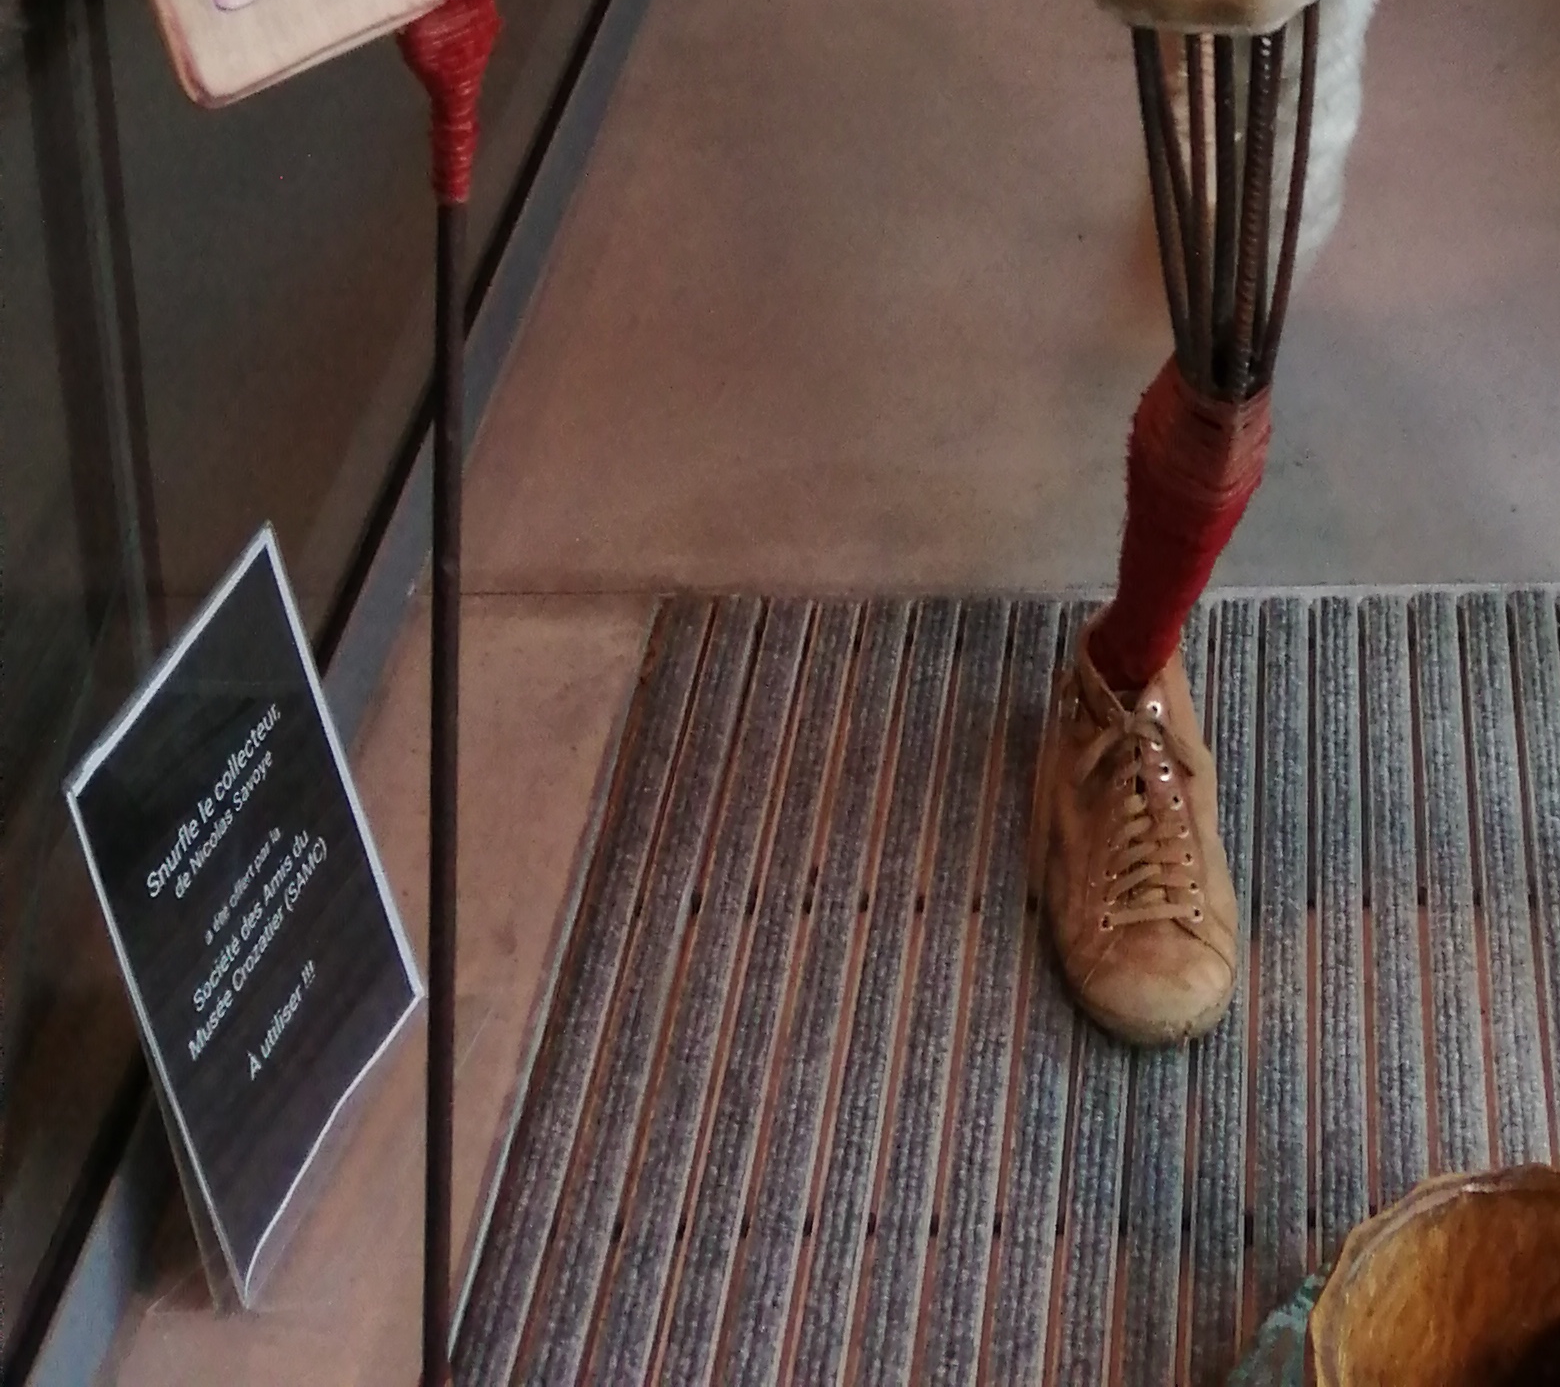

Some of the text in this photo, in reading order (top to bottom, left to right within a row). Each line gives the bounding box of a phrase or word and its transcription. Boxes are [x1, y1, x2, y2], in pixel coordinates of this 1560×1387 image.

[146, 703, 281, 898] Snurfle le collecteur,
[174, 750, 274, 899] de Nicolas Savoye
[229, 864, 255, 908] offert
[254, 842, 271, 874] par
[188, 836, 328, 1061] Musée Crozatier (SAMC)
[193, 830, 309, 1012] Société des Amis du
[246, 1050, 262, 1081] À
[260, 984, 303, 1059] utiliser
